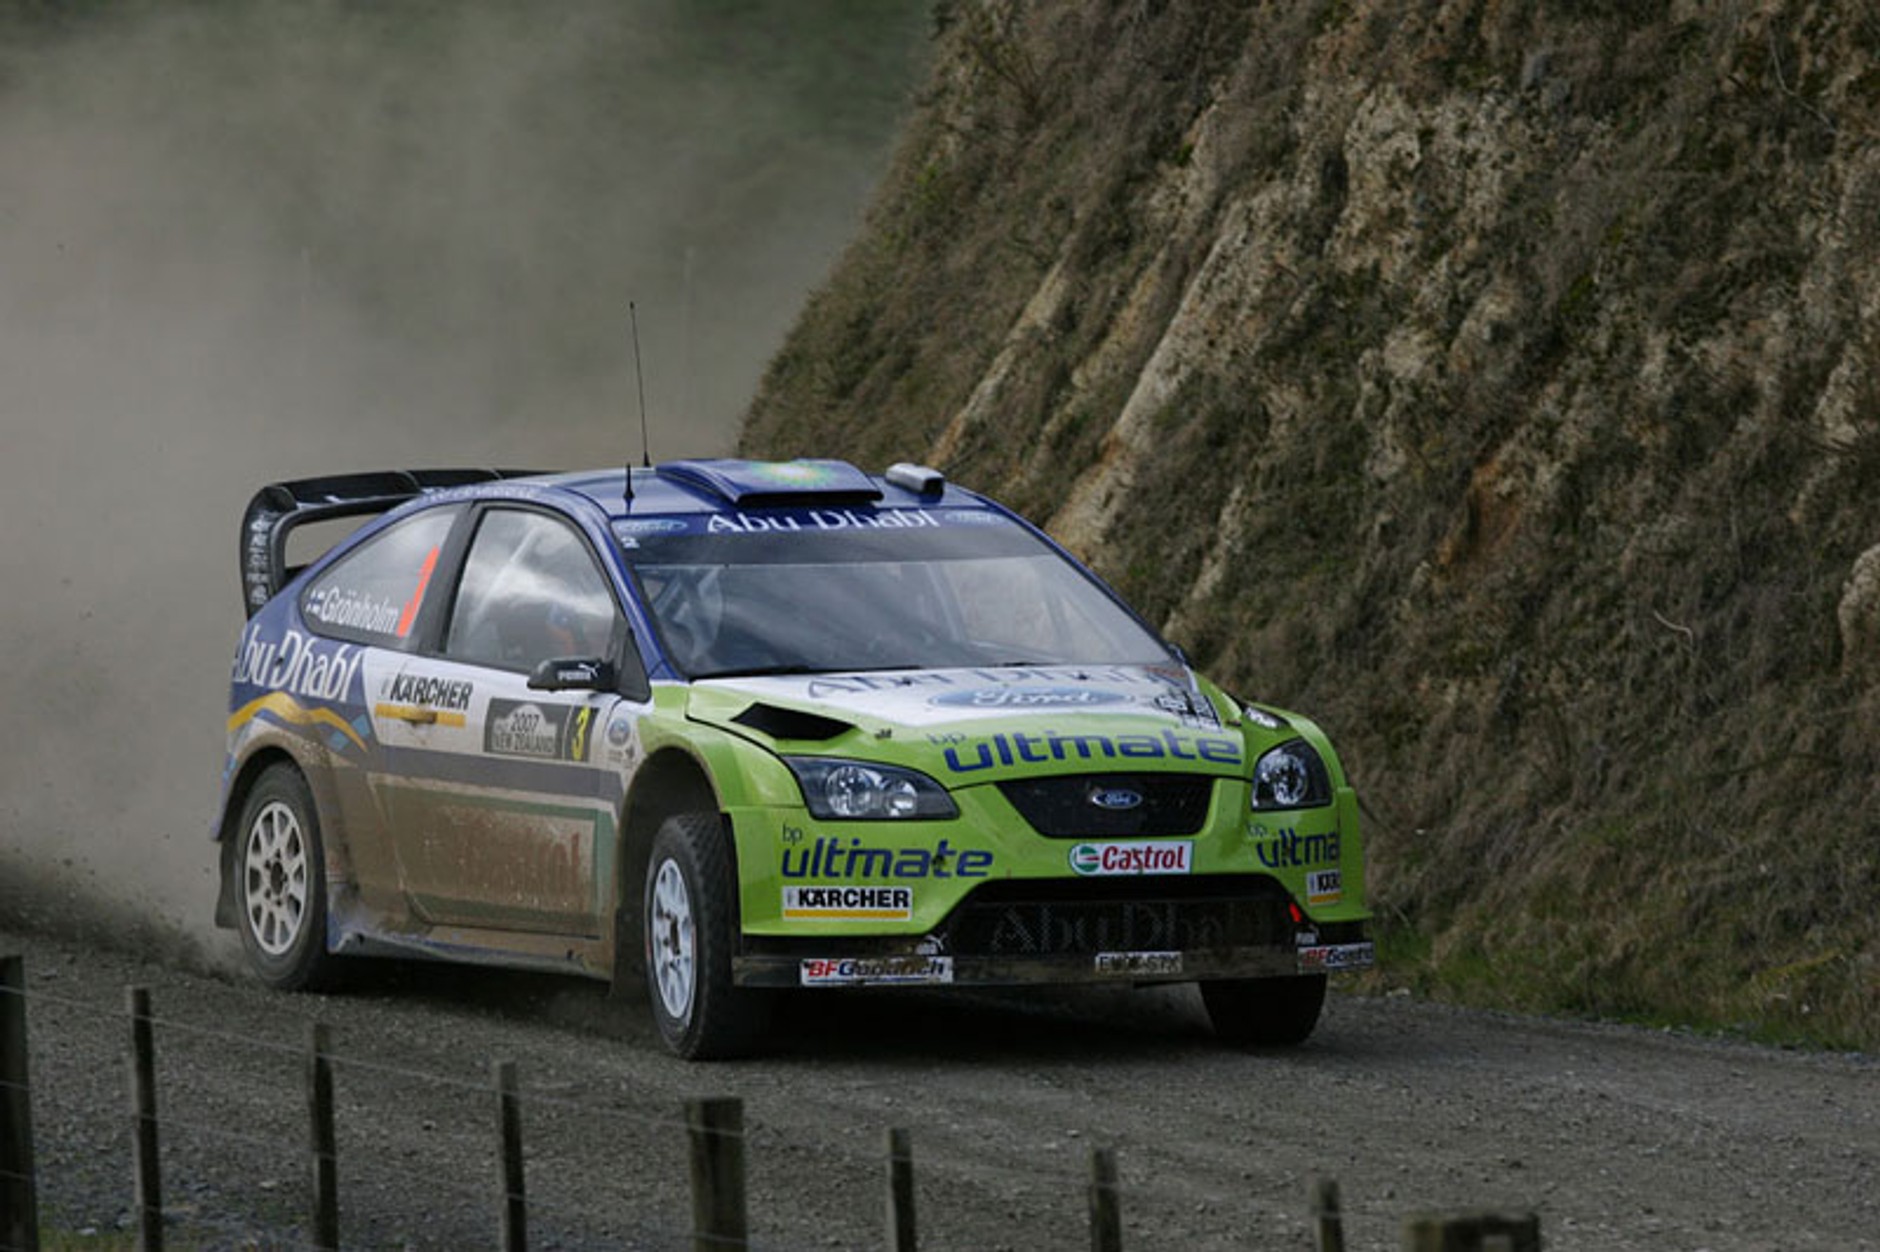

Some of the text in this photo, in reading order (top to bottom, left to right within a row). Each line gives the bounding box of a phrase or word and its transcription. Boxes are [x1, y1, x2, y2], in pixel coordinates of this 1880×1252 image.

[706, 512, 802, 533] Abu
[809, 508, 941, 530] Dhabi
[943, 730, 1242, 773] ultimate
[782, 823, 803, 846] bp
[781, 836, 994, 878] ultimate
[1102, 845, 1185, 871] Castrol
[798, 888, 910, 908] KÄRCHER
